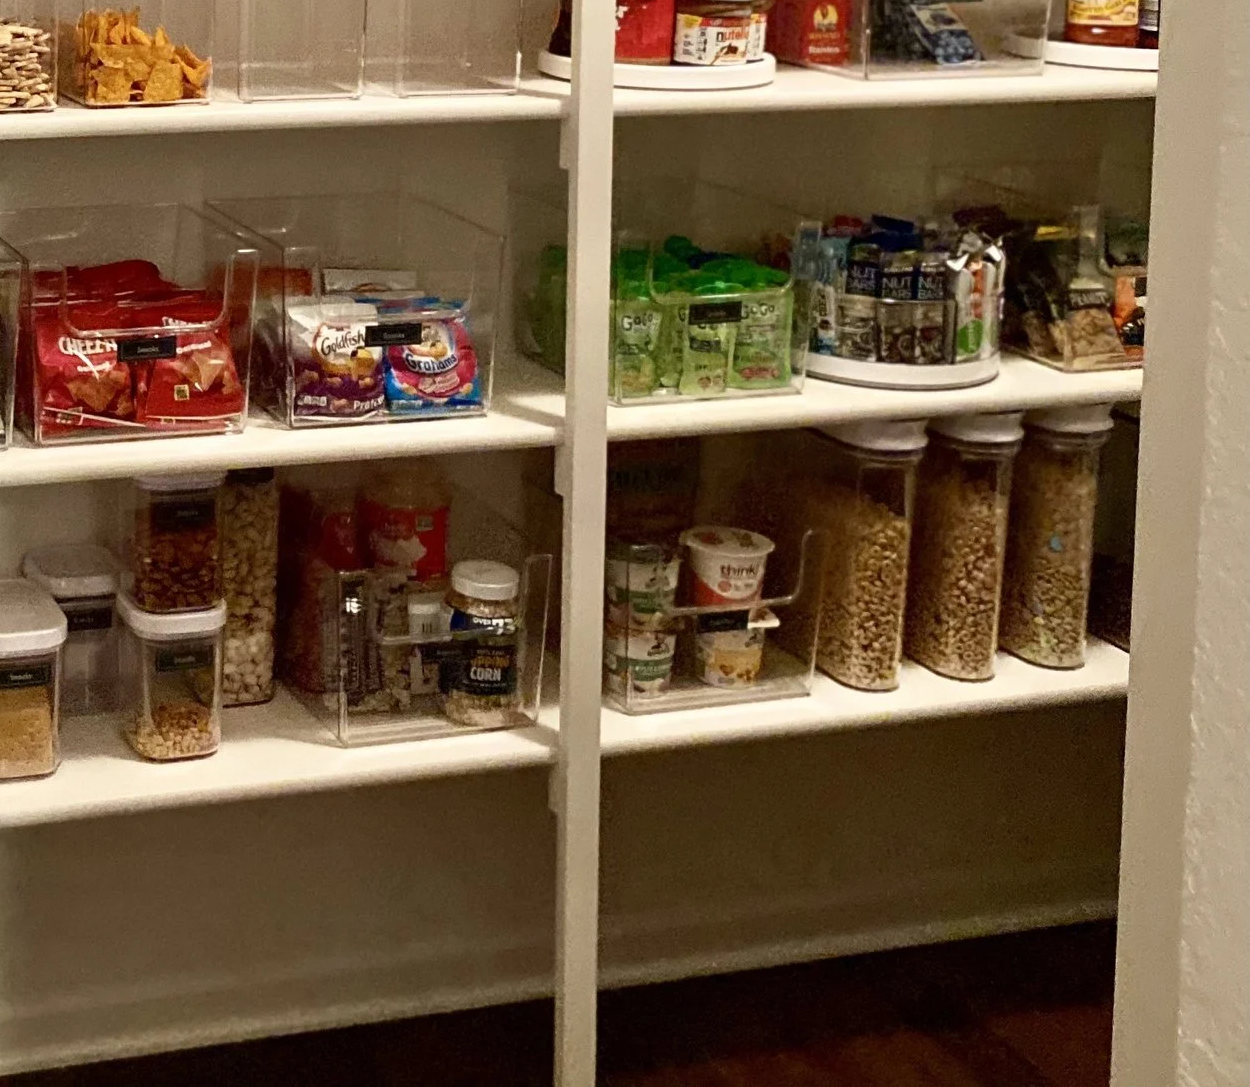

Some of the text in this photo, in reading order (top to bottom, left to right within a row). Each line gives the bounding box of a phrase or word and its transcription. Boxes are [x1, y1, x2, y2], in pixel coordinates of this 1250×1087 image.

[881, 276, 912, 290] NUT
[918, 275, 945, 289] NUT
[320, 328, 366, 356] Goldfish
[405, 352, 458, 372] Grahams
[469, 666, 502, 682] CORN
